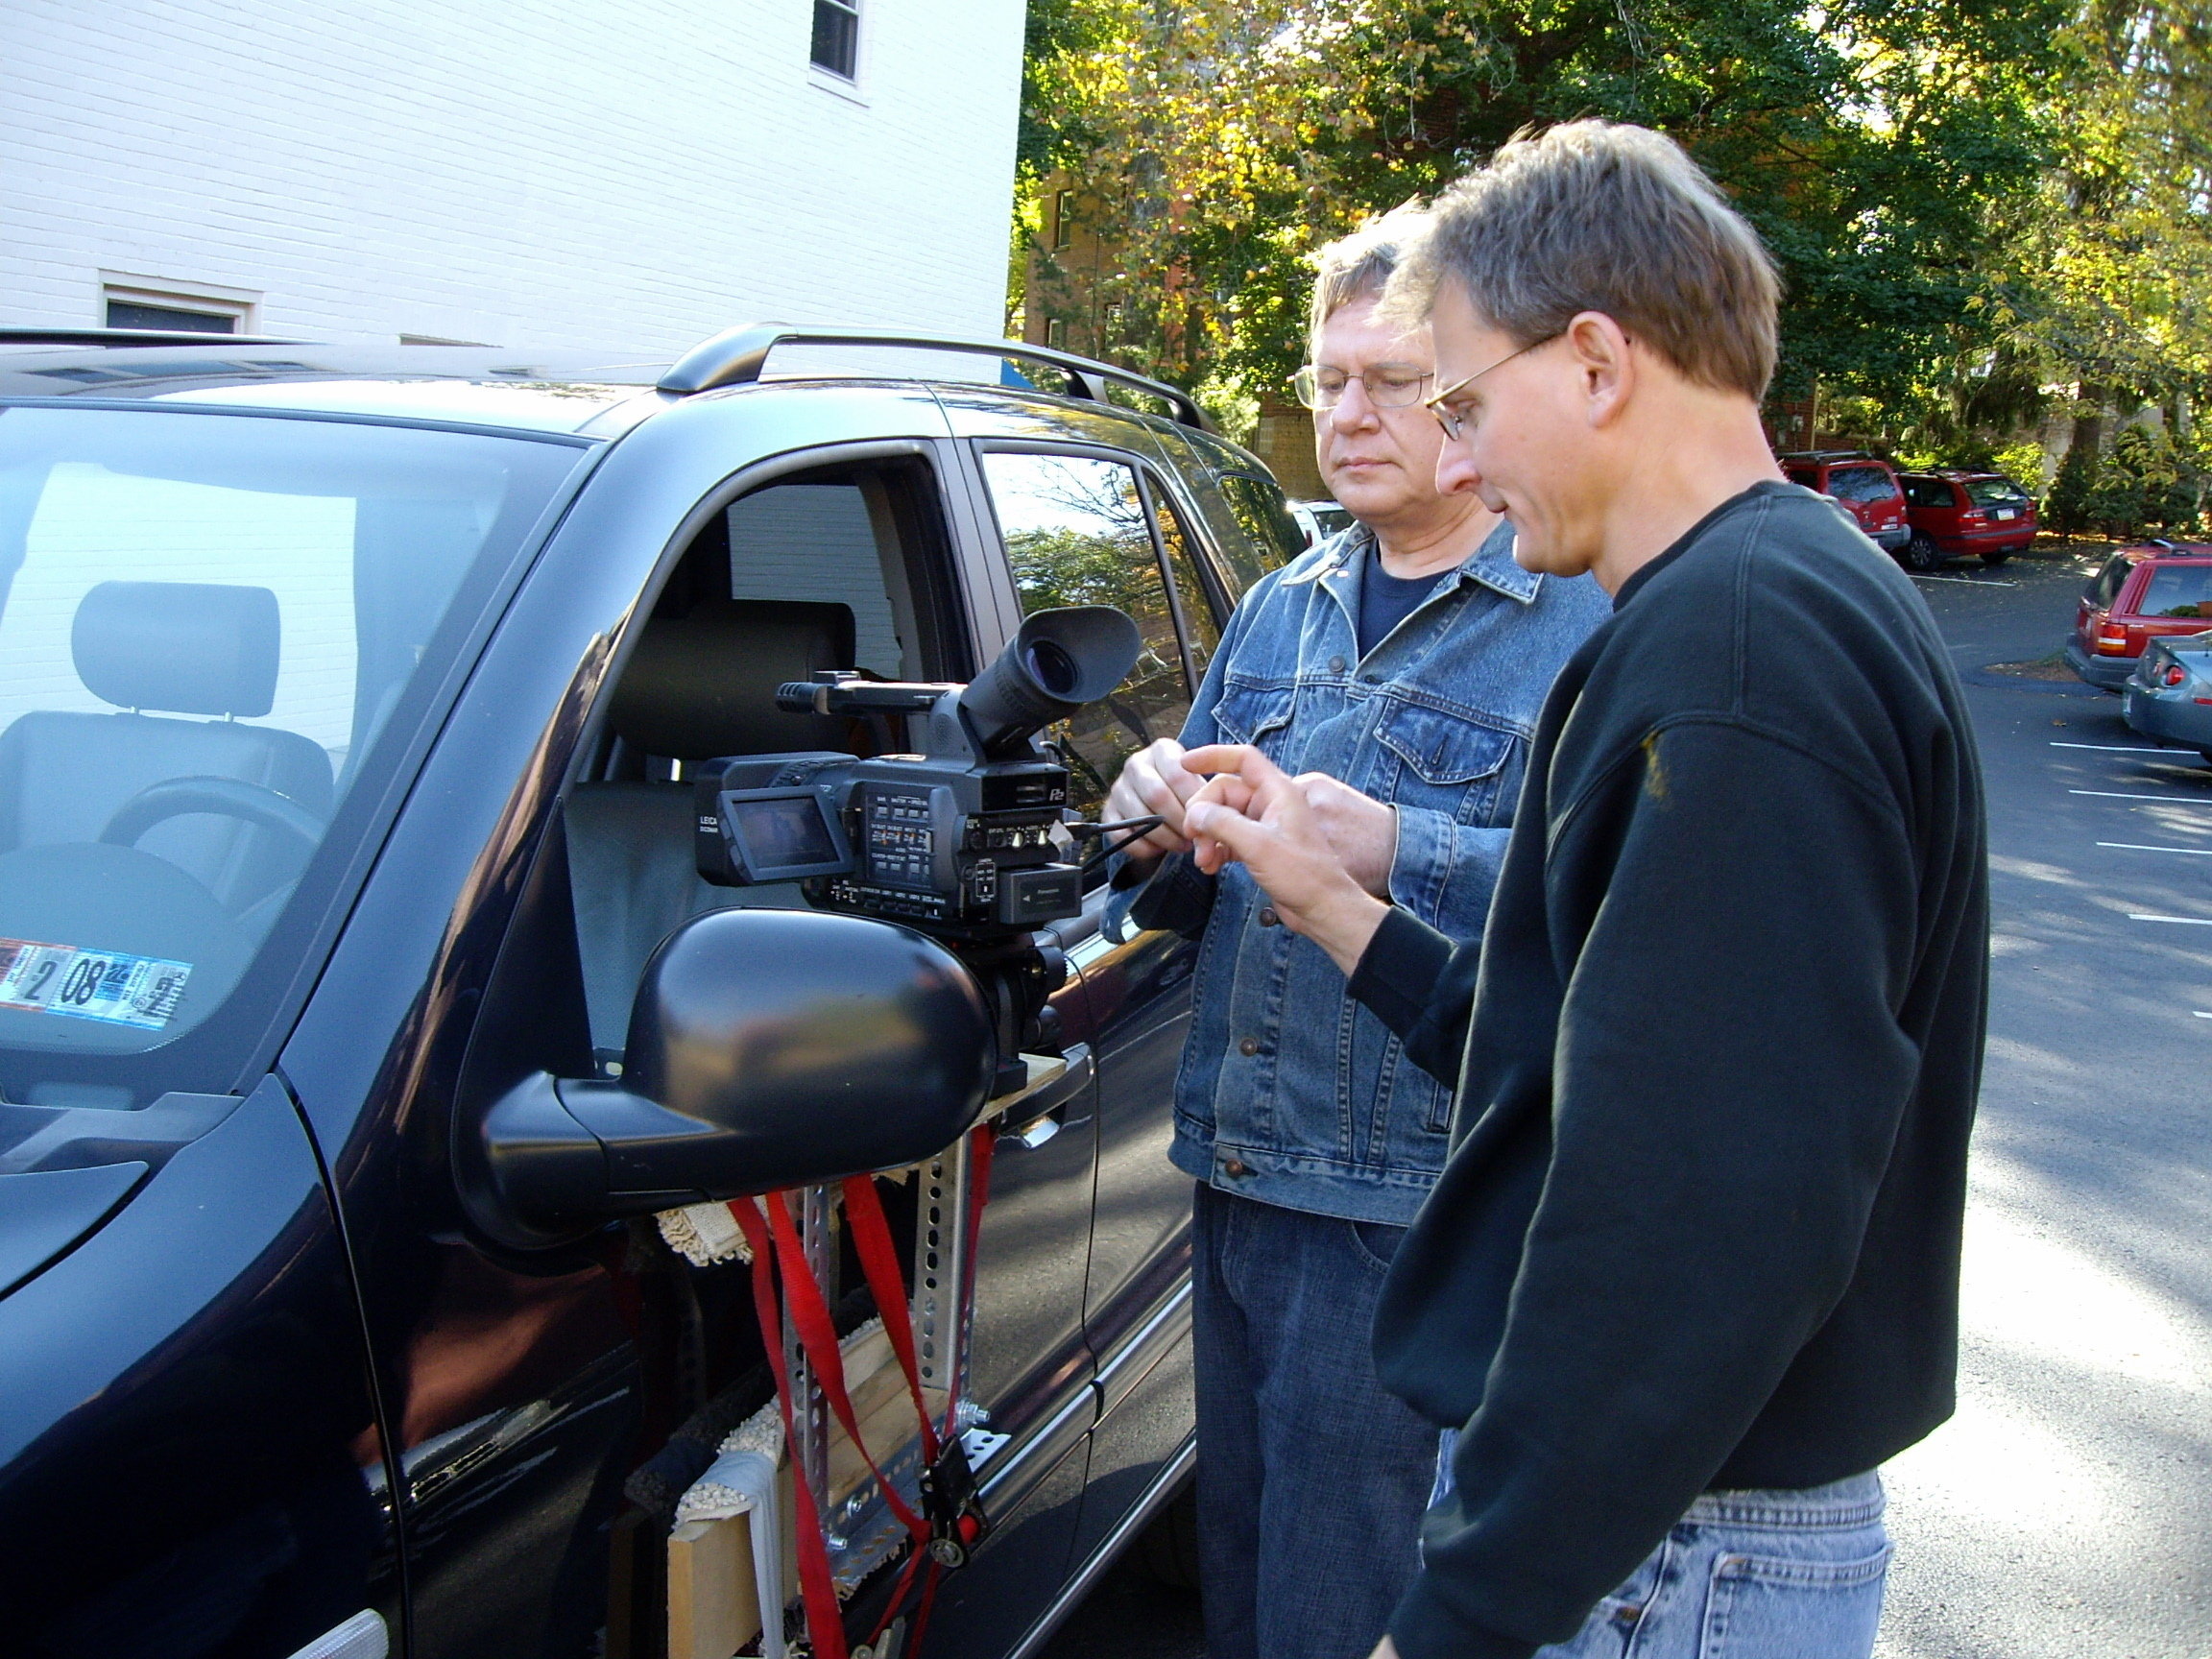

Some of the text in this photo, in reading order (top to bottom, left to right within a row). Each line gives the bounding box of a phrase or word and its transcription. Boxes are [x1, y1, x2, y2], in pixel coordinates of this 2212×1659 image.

[1049, 788, 1065, 801] P2
[25, 961, 57, 1000] 2
[60, 958, 107, 1005] 08
